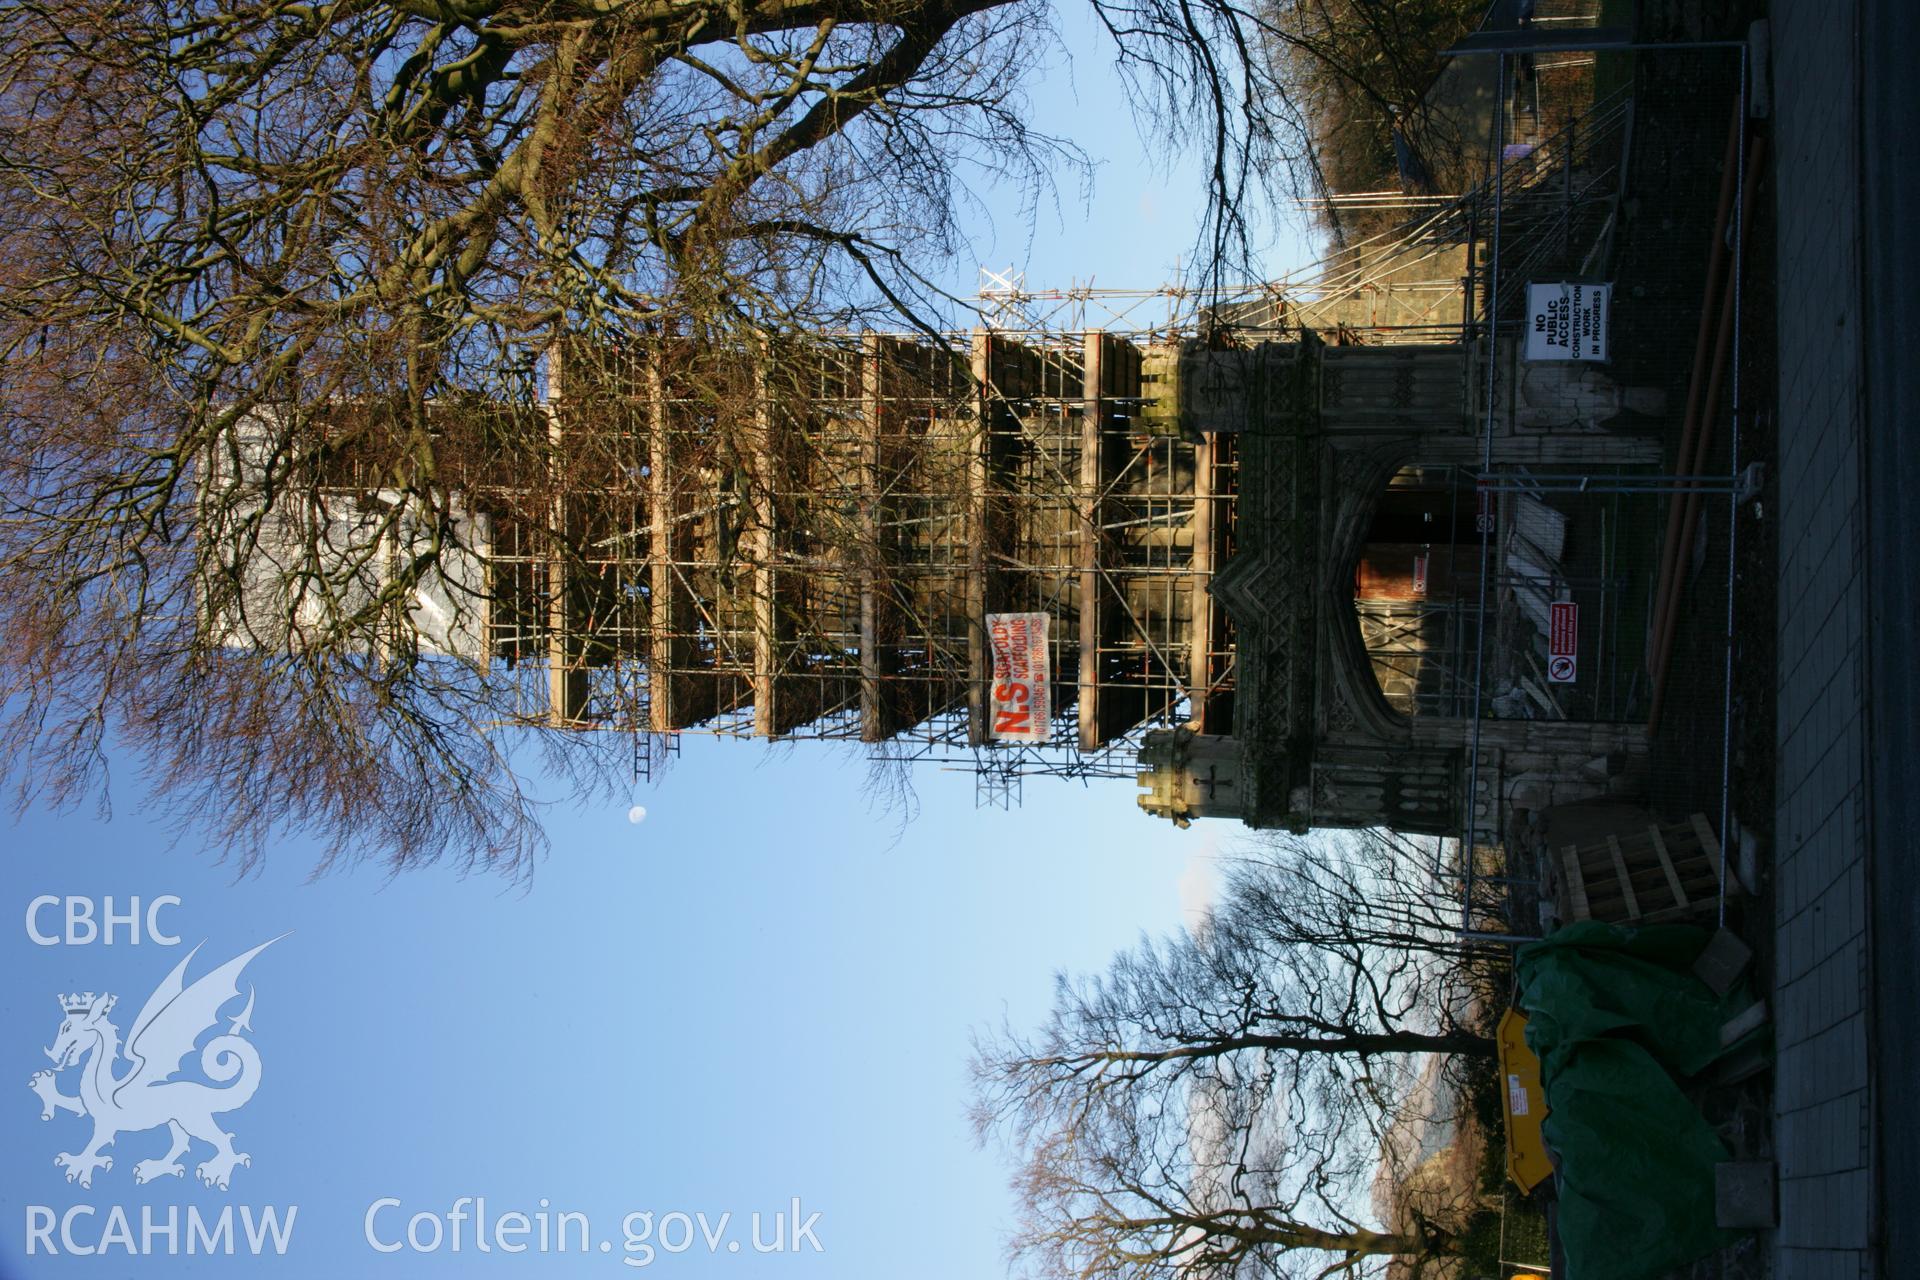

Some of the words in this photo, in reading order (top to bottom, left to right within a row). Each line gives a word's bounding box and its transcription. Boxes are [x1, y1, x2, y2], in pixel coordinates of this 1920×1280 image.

[1536, 314, 1546, 332] NO
[1547, 300, 1558, 345] PUBLIC
[1559, 296, 1570, 347] ACCESS
[1572, 285, 1581, 359] CONSTRUCTION
[1583, 308, 1591, 337] WORK
[1592, 290, 1601, 341] PROGRESS
[1592, 345, 1600, 354] IN
[1010, 619, 1029, 679] SCAFFOLDING
[993, 682, 1030, 733] N.S
